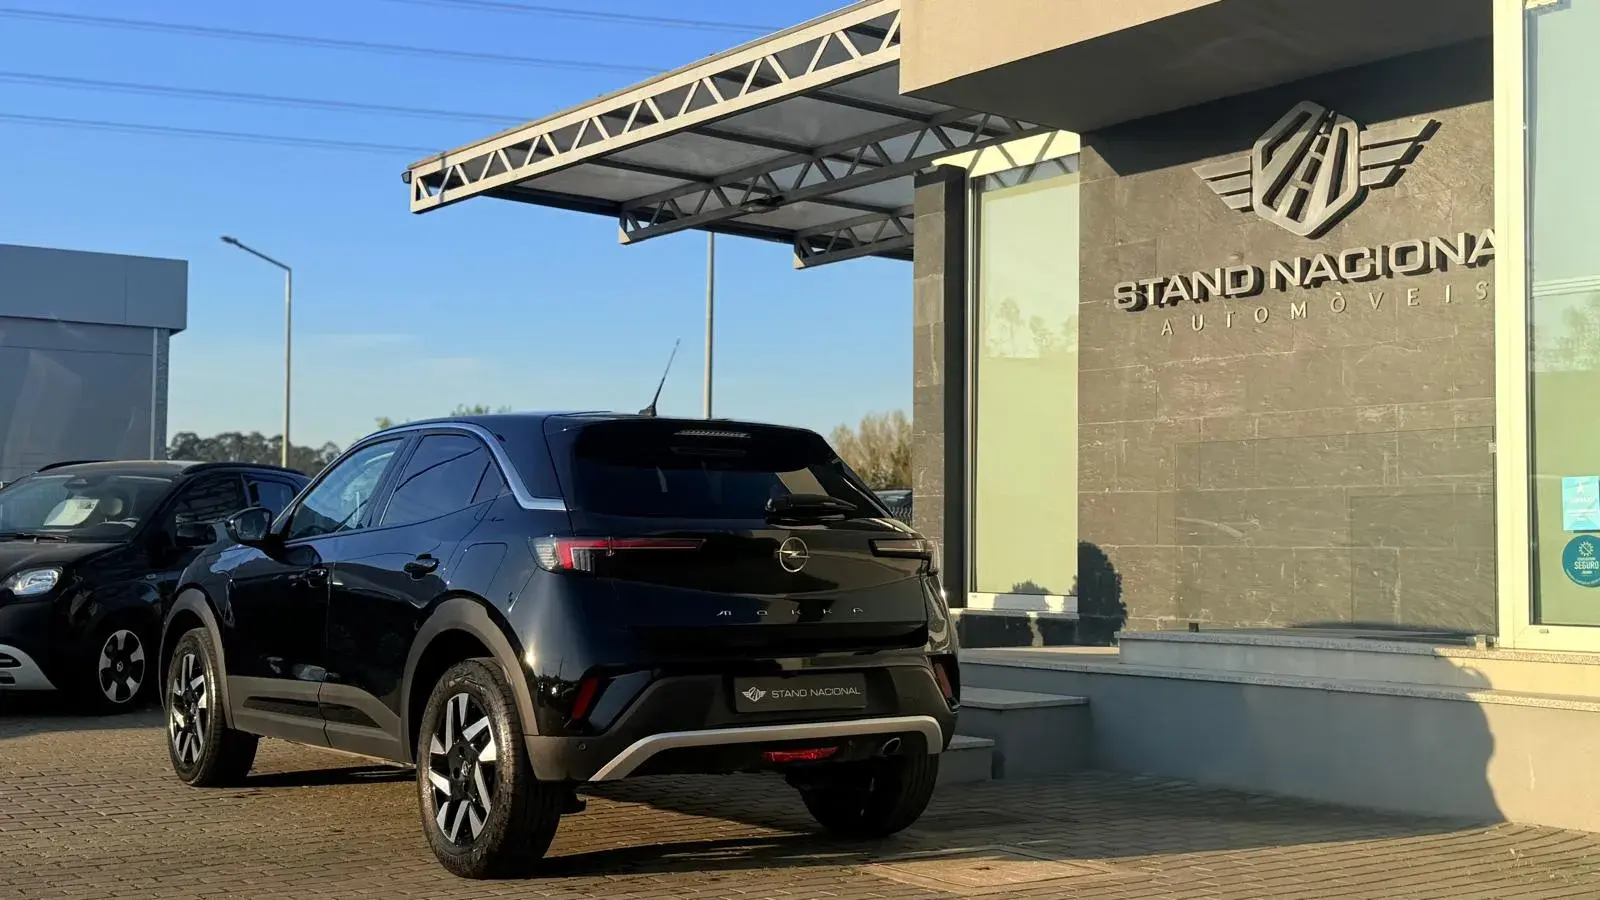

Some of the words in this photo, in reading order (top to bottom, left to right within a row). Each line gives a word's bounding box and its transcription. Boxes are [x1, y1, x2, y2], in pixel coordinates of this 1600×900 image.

[1113, 264, 1256, 310] STAND
[1160, 280, 1489, 336] AUTOMÒVEIS
[1574, 560, 1599, 570] SEGURO
[716, 606, 865, 618] MOKKA
[771, 688, 808, 699] STAND
[810, 686, 861, 697] NACIONAL
